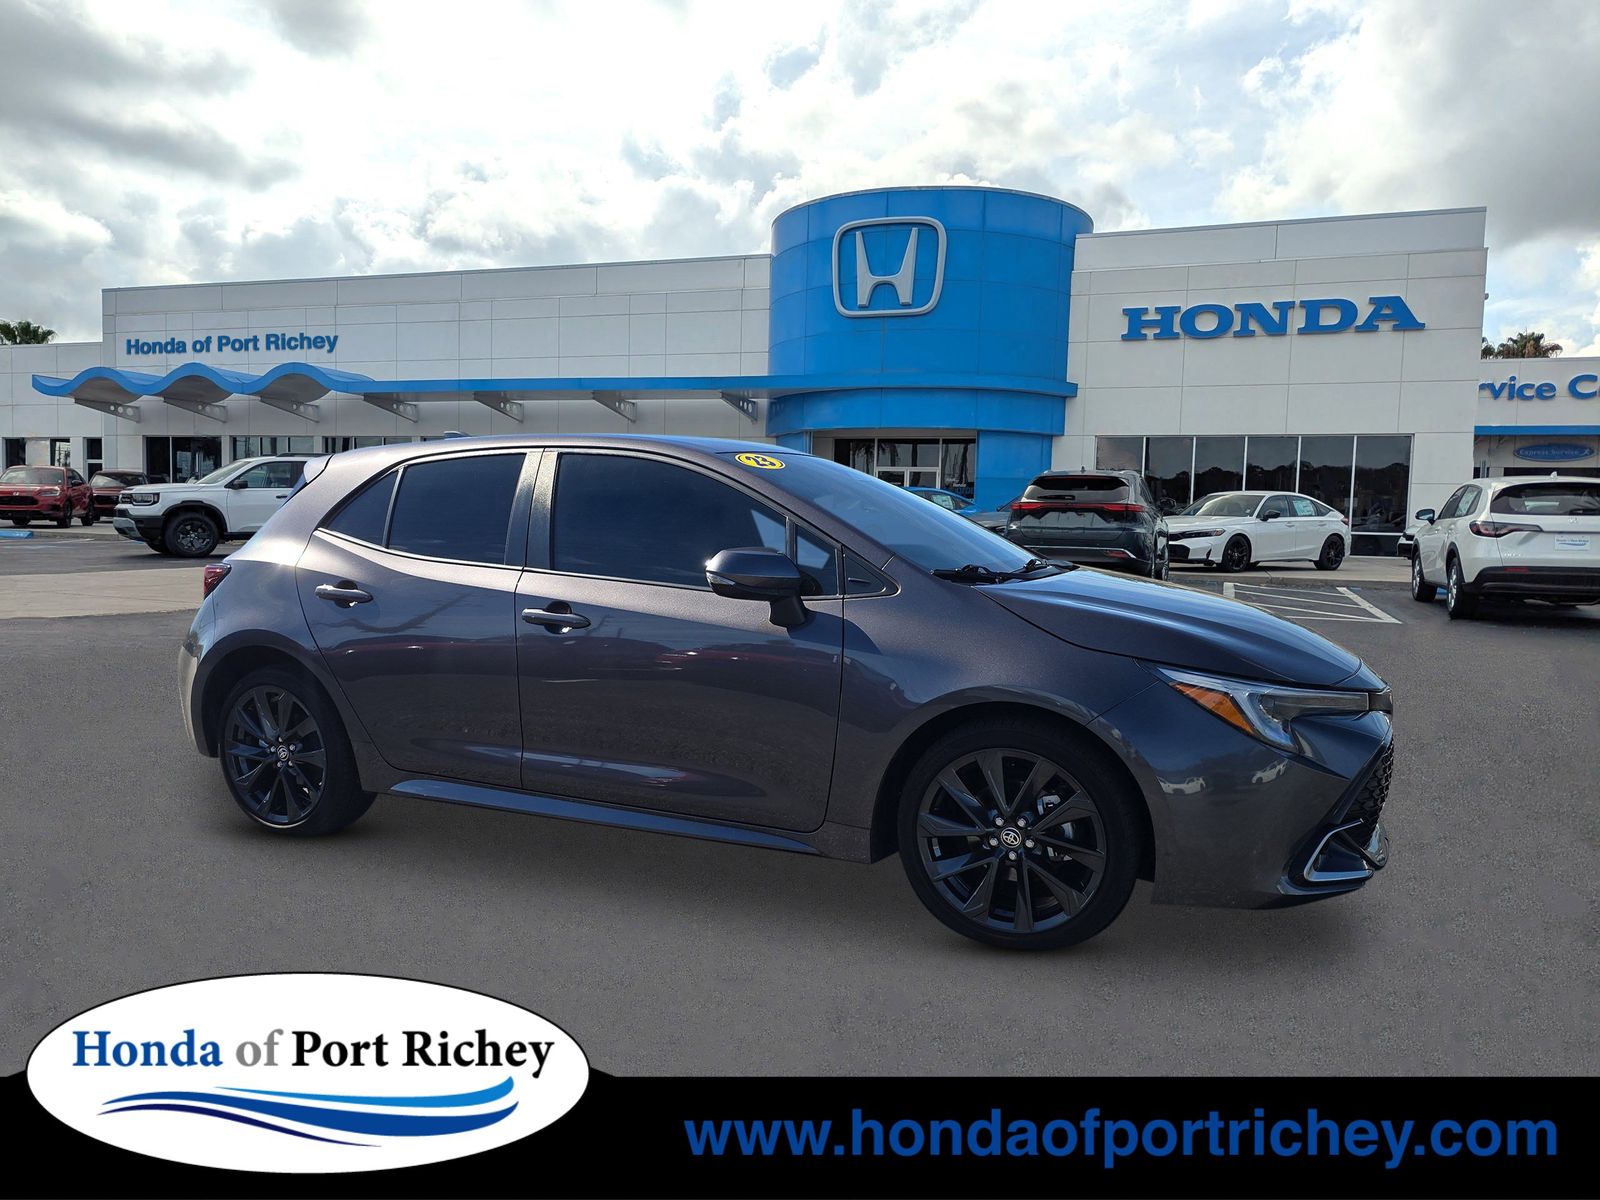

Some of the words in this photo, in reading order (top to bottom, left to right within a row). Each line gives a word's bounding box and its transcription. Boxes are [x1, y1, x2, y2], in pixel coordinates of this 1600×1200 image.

[1120, 295, 1426, 341] HONDA
[126, 337, 187, 355] Honda
[192, 335, 212, 353] of
[217, 334, 259, 352] Port
[265, 332, 339, 353] Richey
[745, 455, 777, 467] 23
